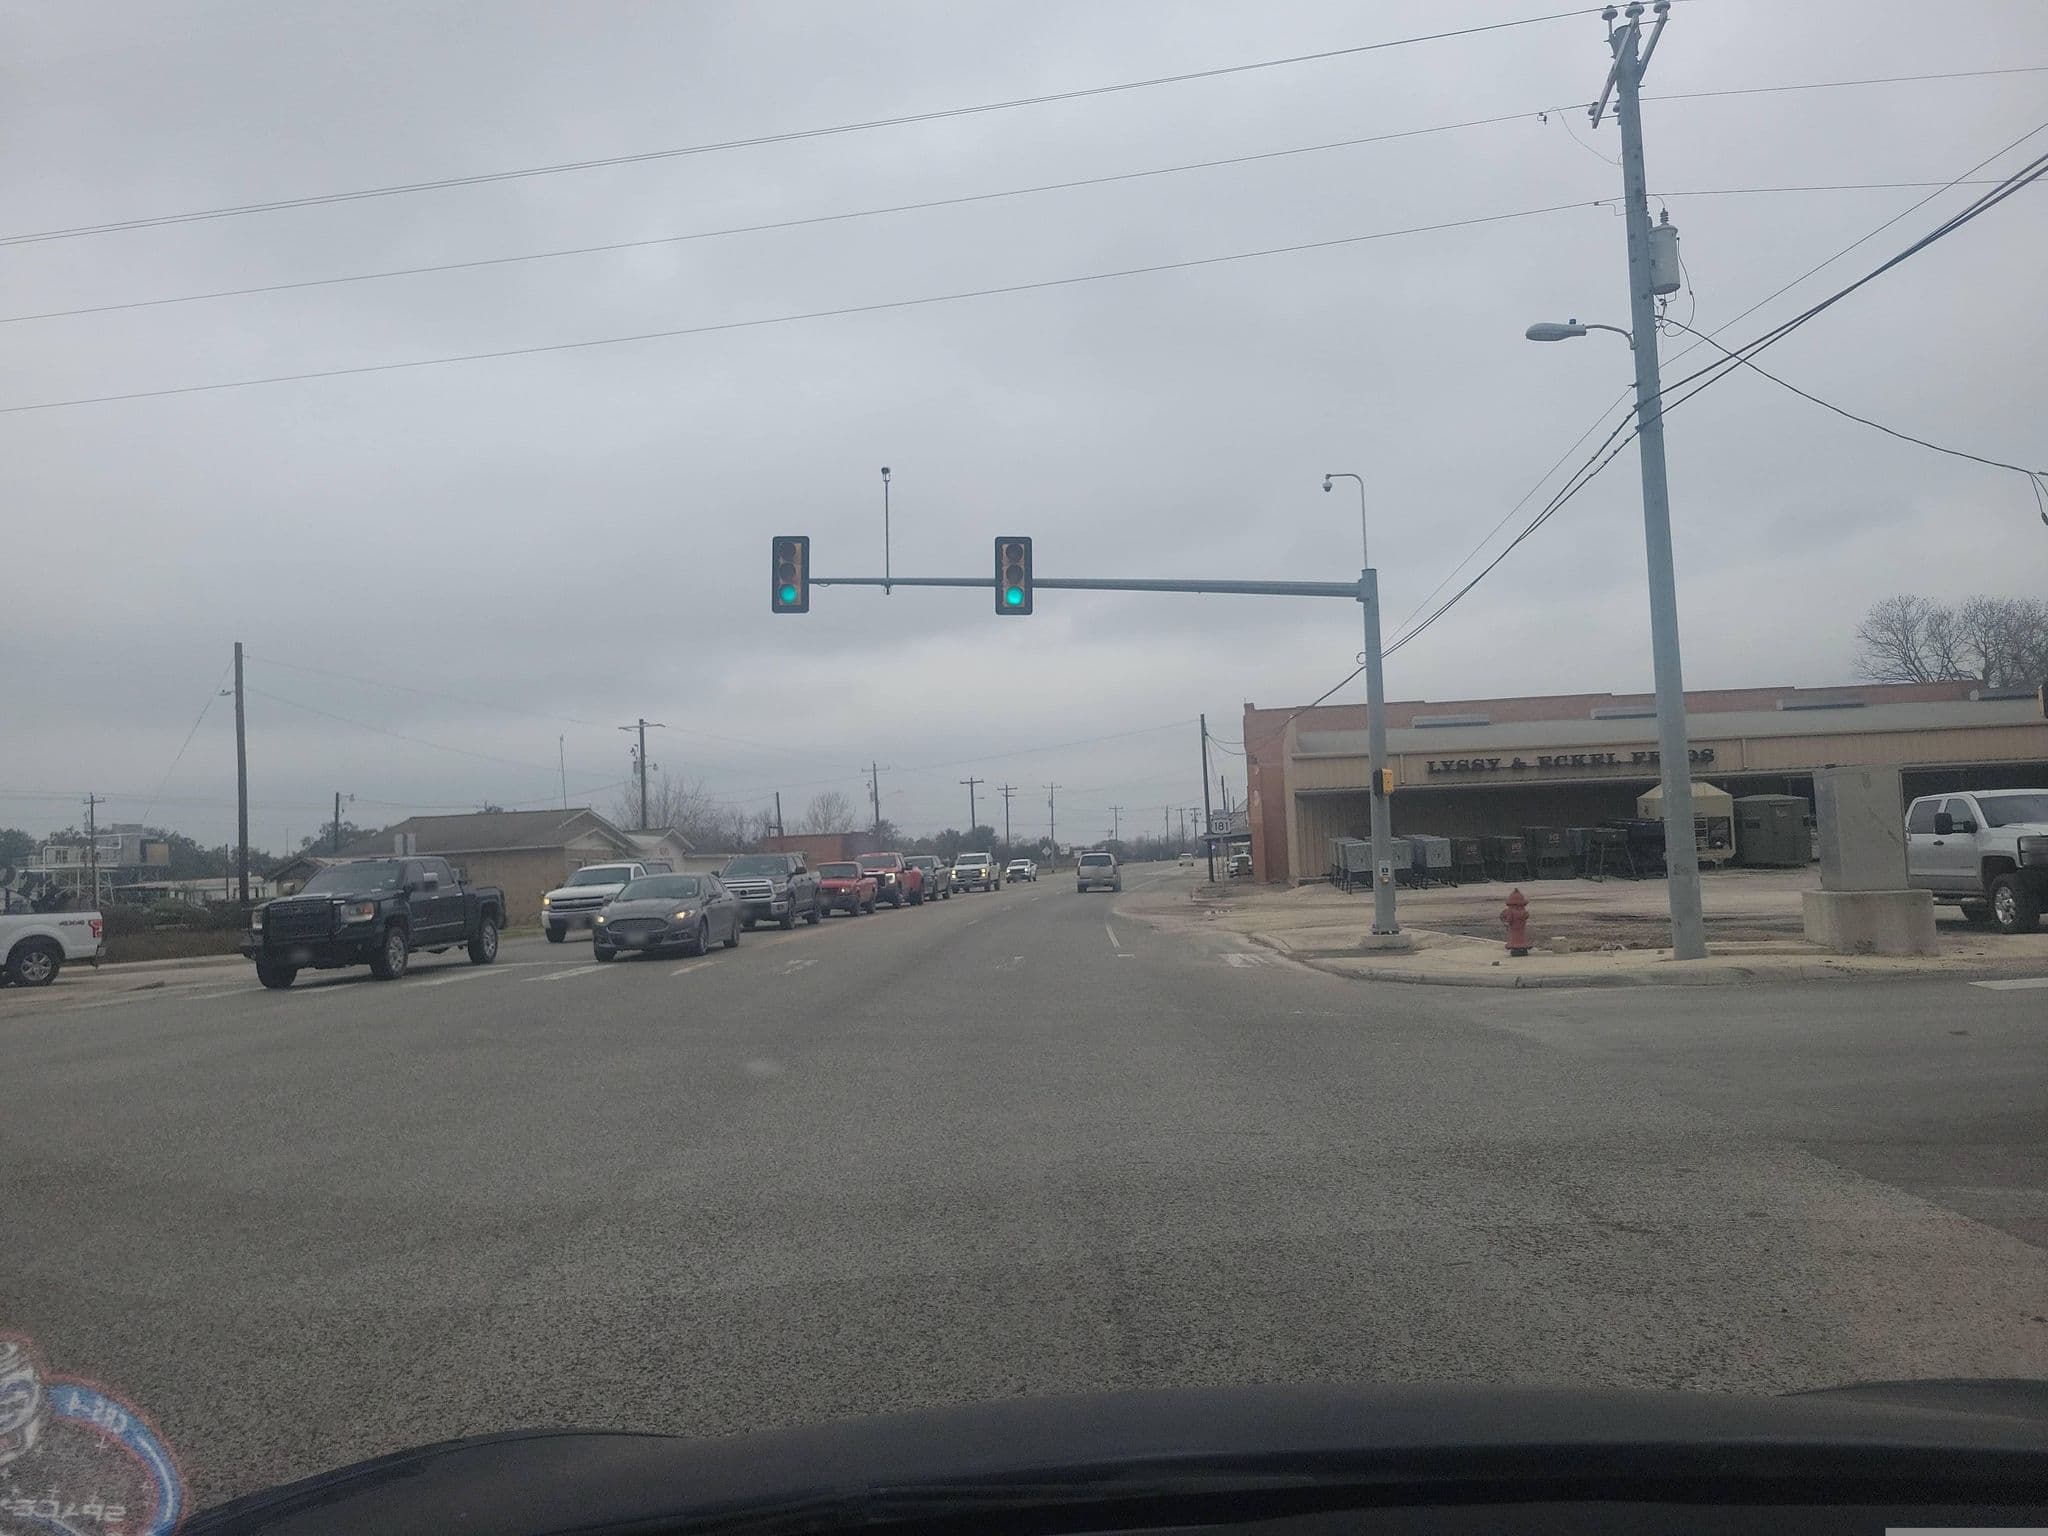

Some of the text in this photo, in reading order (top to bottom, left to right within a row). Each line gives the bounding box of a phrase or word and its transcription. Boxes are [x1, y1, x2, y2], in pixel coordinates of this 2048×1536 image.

[1511, 757, 1528, 769] &
[1631, 748, 1715, 766] FEDS
[1214, 821, 1229, 832] 181
